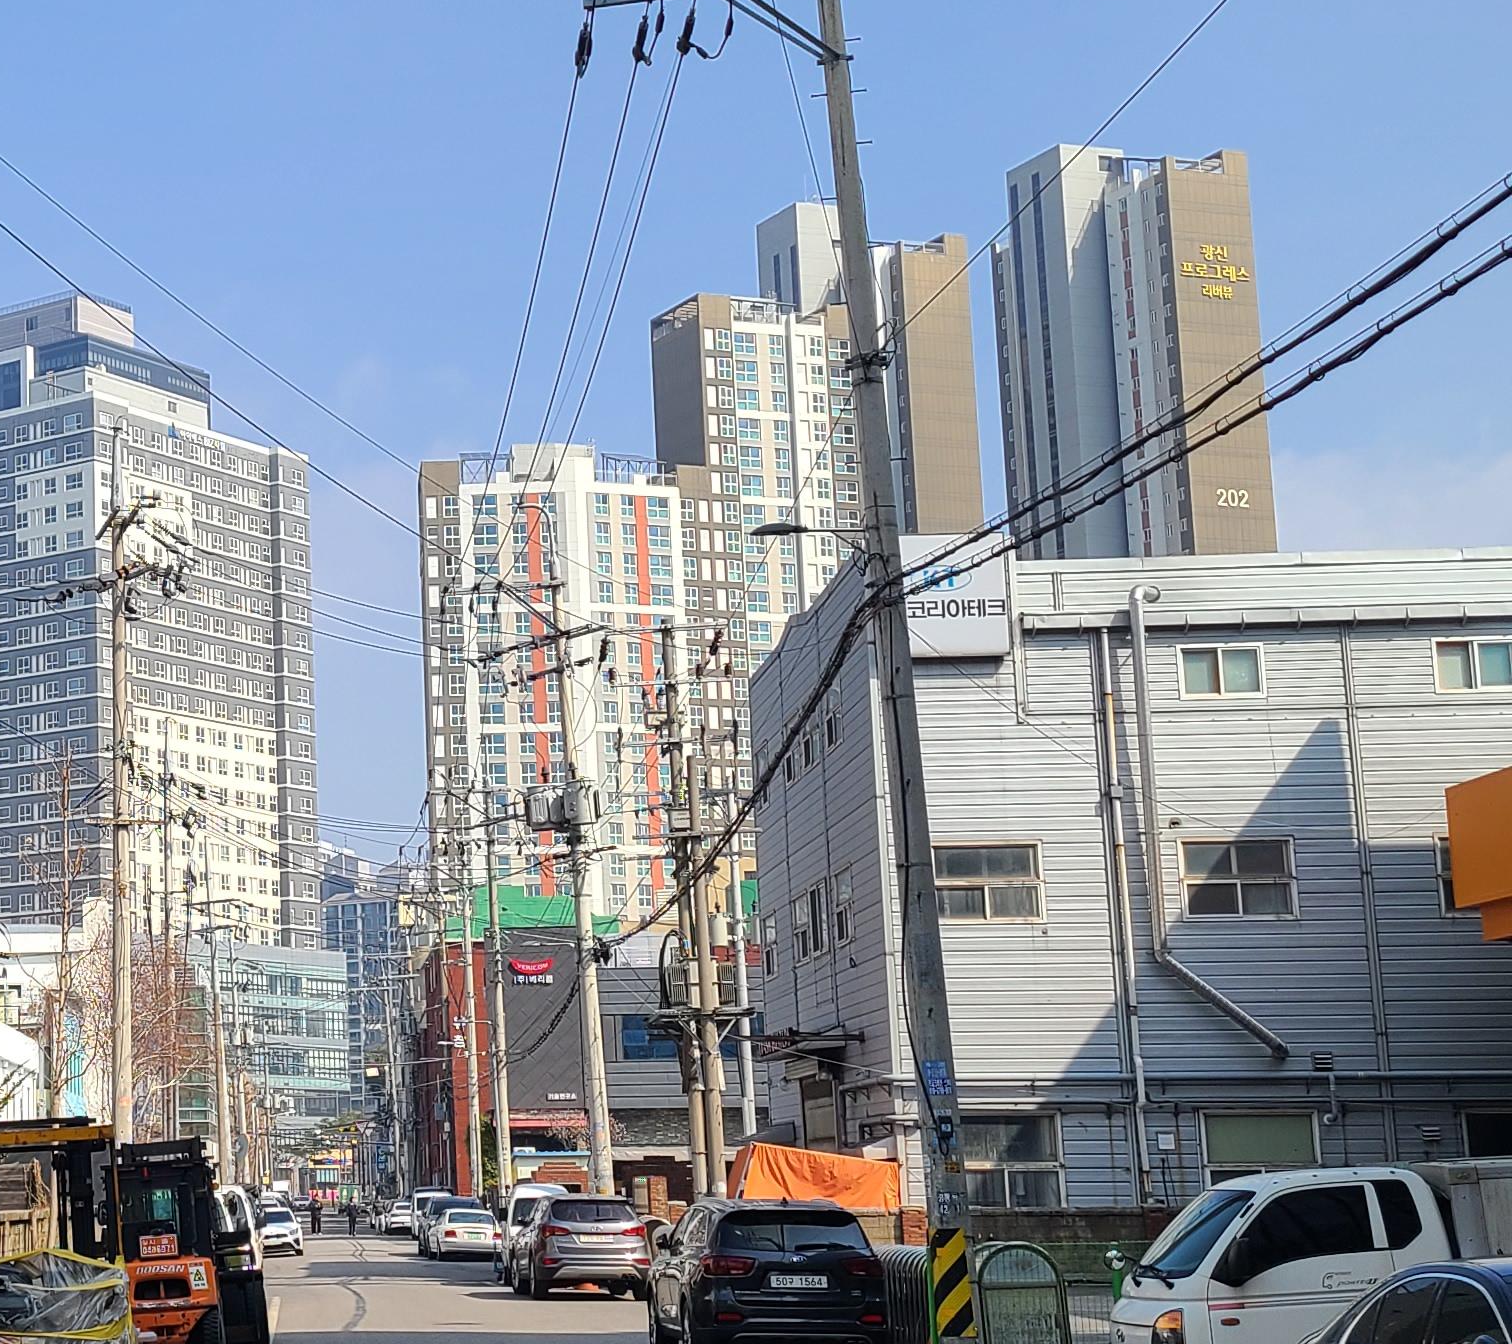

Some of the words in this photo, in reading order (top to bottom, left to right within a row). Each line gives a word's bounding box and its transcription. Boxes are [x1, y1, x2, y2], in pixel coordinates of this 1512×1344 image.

[1199, 244, 1229, 262] 광신
[1180, 261, 1250, 283] 프로그레스
[1201, 283, 1233, 300] 리버뷰
[1216, 488, 1250, 508] 202
[907, 599, 1007, 619] 코리아테크
[517, 962, 549, 972] VERICOM
[136, 1264, 185, 1275] DOOSAN
[799, 1277, 823, 1286] 1564
